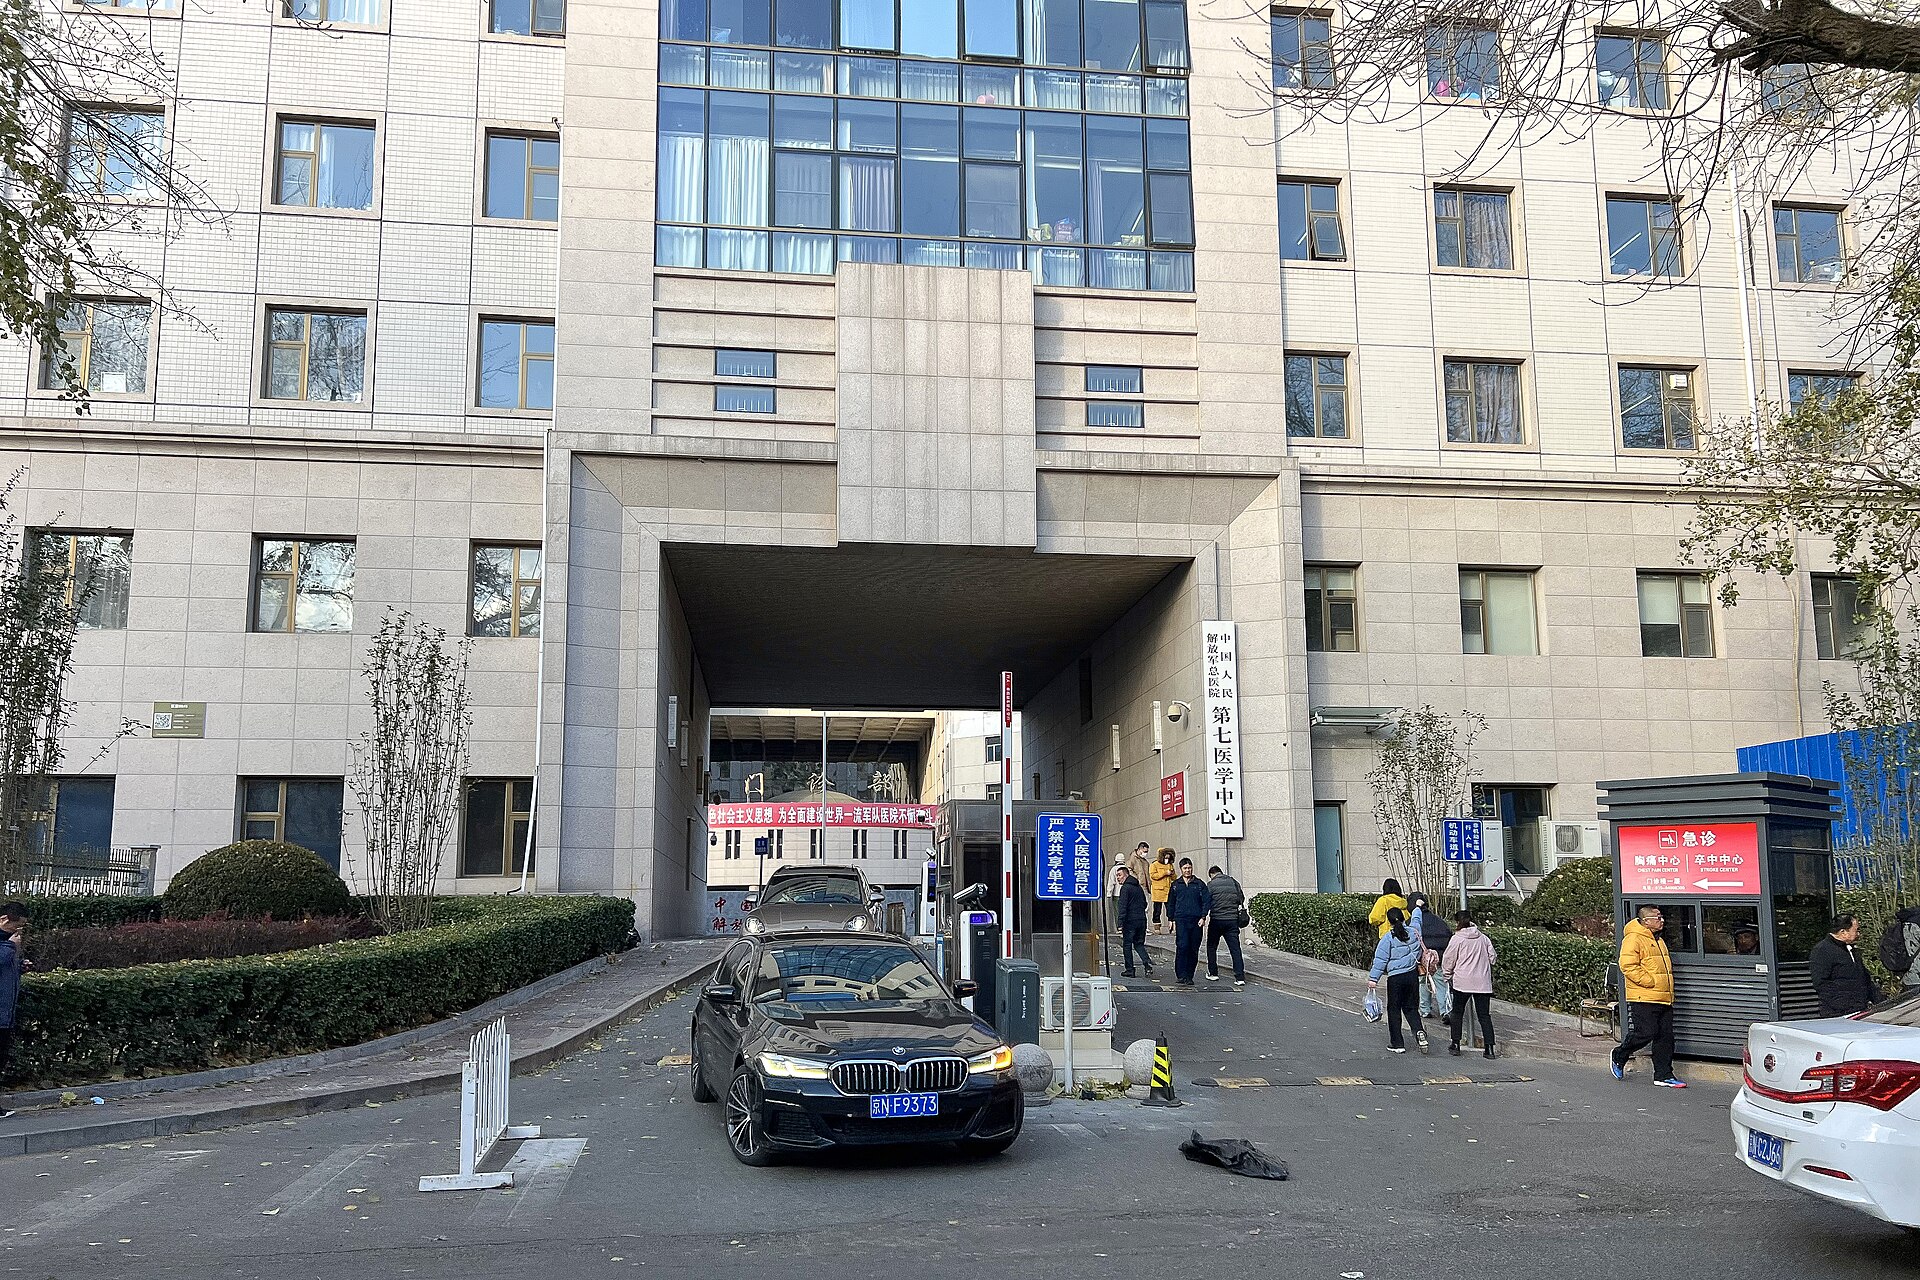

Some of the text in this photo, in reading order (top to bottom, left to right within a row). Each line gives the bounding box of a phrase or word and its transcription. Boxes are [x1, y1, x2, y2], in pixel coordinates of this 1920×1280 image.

[1206, 633, 1220, 698] 解放军总医院
[1220, 633, 1233, 698] 中国人民
[1212, 706, 1236, 825] 第七医学中心
[1047, 817, 1064, 895] 严禁共享单车
[1074, 818, 1091, 895] 进入医院营区
[1634, 855, 1681, 866] 胸痛中心
[1682, 830, 1717, 847] 急诊
[1694, 853, 1744, 866] 卒中中心
